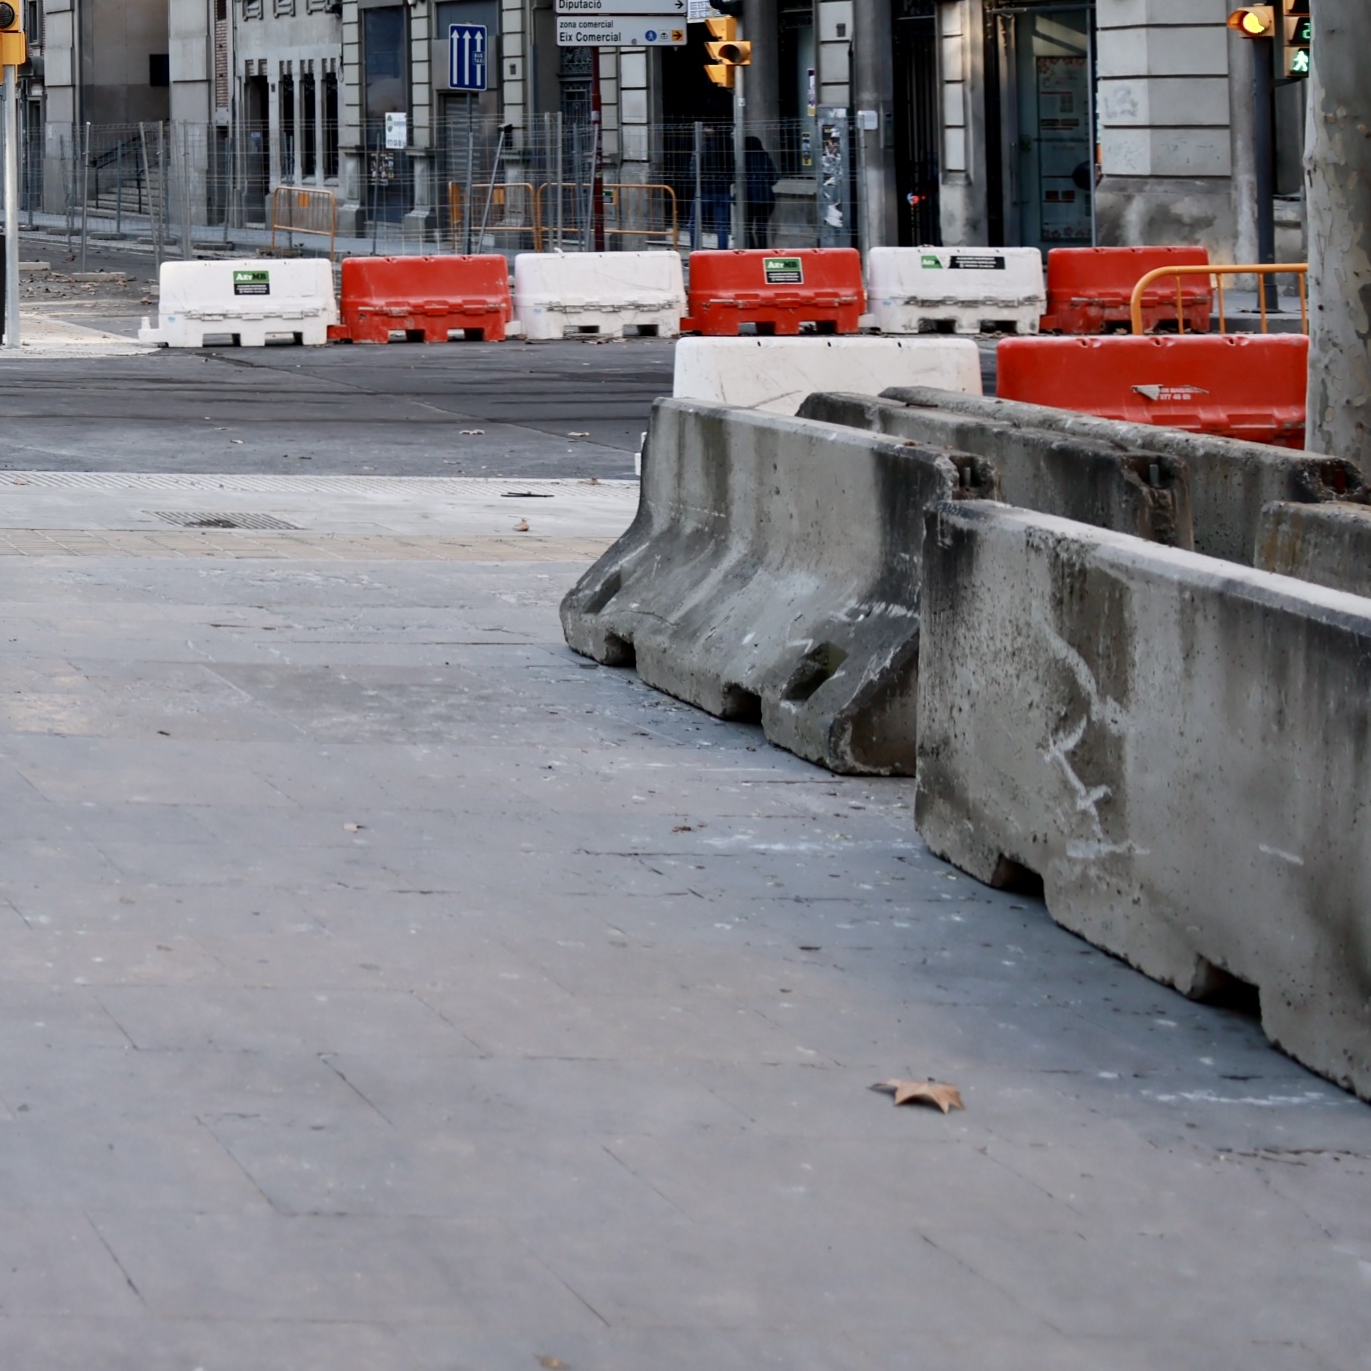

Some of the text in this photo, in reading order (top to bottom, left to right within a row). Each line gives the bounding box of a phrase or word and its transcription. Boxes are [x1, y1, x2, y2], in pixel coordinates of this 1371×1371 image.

[578, 20, 614, 29] comercial
[559, 32, 622, 42] Eix Comercial
